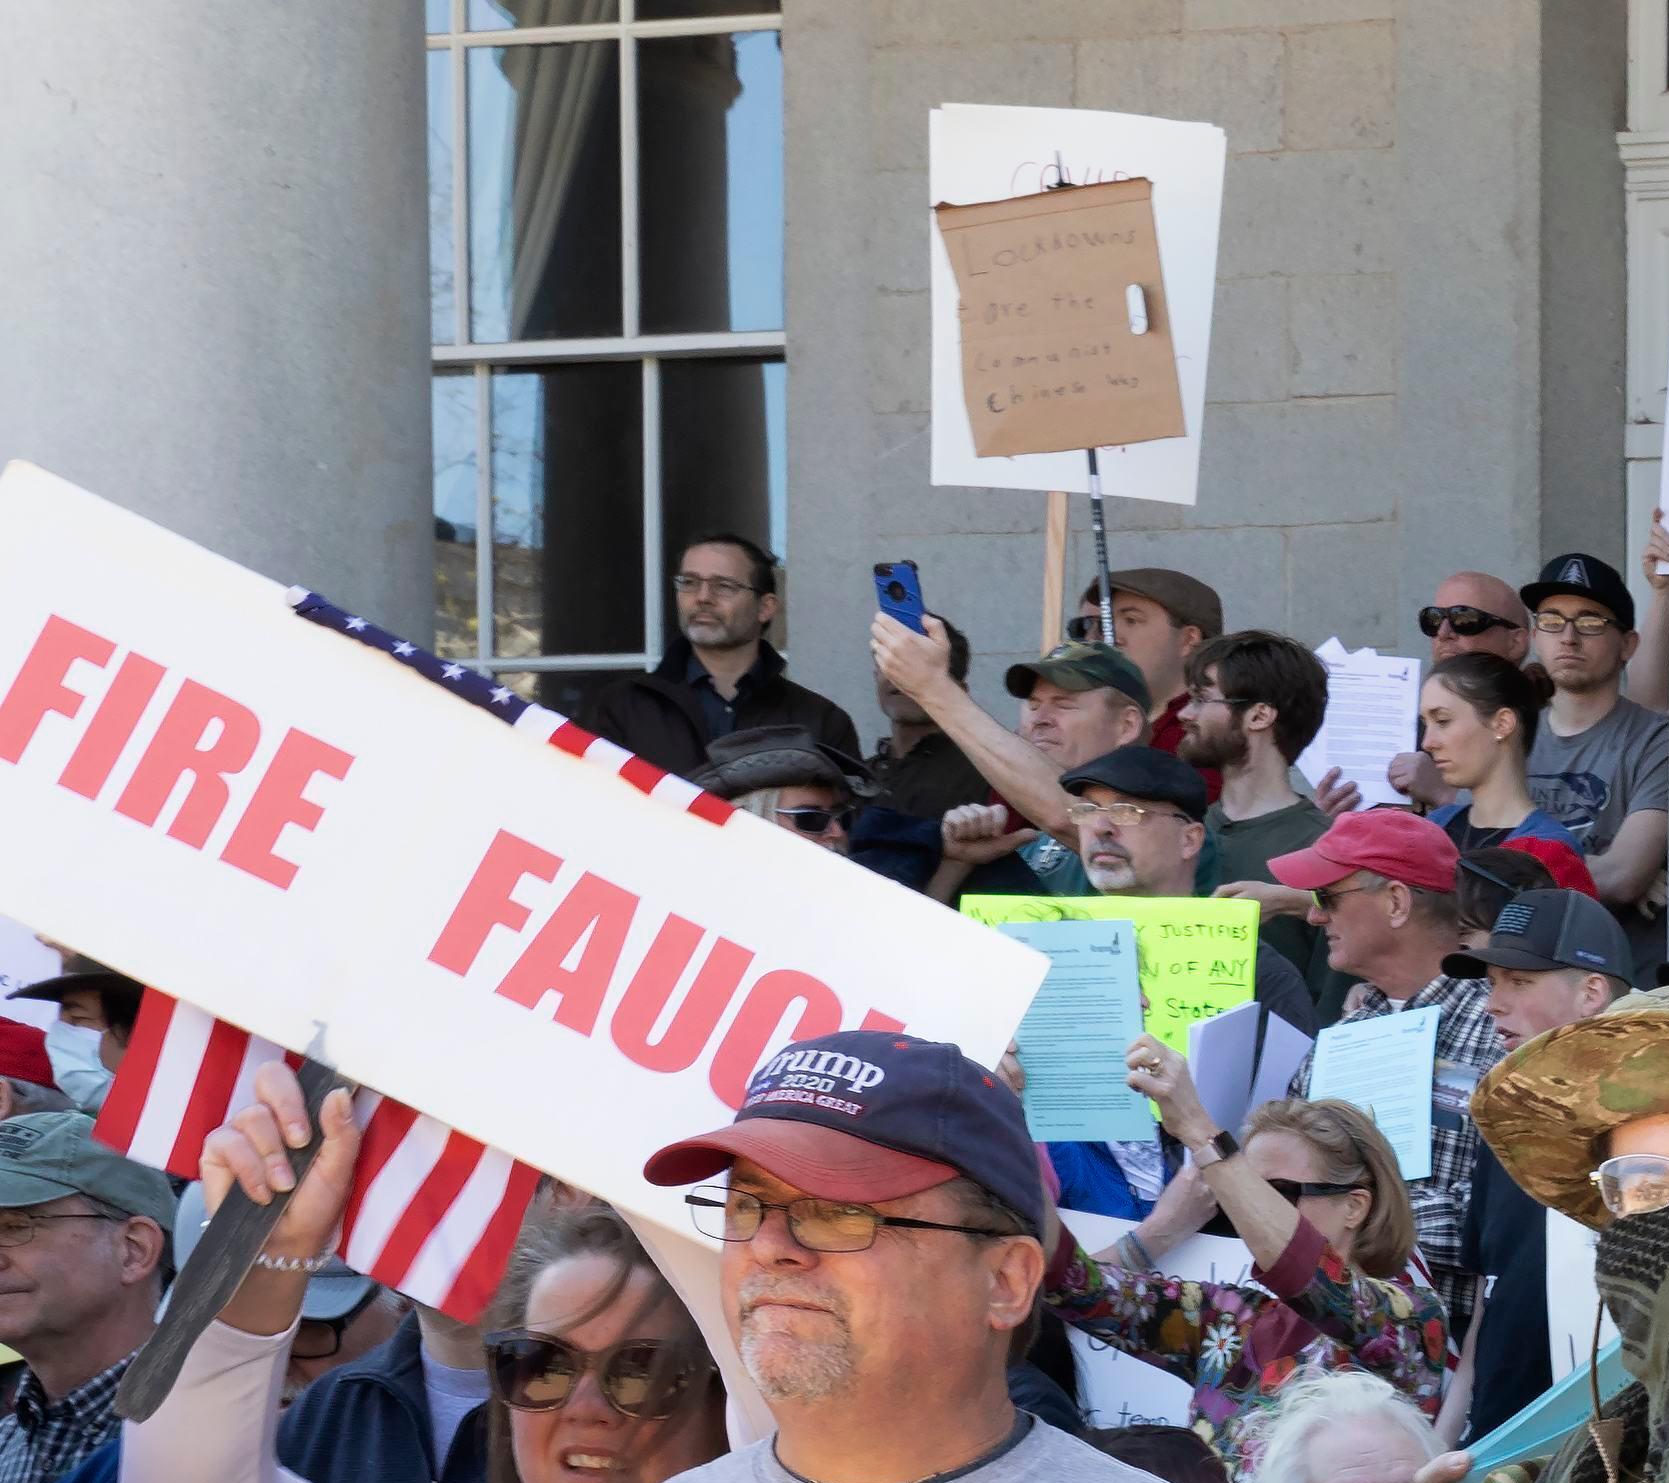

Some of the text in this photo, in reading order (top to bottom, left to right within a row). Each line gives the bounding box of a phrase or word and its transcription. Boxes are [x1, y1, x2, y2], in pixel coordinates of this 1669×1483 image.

[0, 613, 357, 892] FIRE
[426, 827, 908, 1114] FAUC
[1159, 924, 1249, 942] JUSTIFIES
[1171, 961, 1196, 976] OF
[1209, 958, 1248, 977] ANY
[780, 1074, 836, 1093] 2020
[815, 1094, 863, 1116] GREAT
